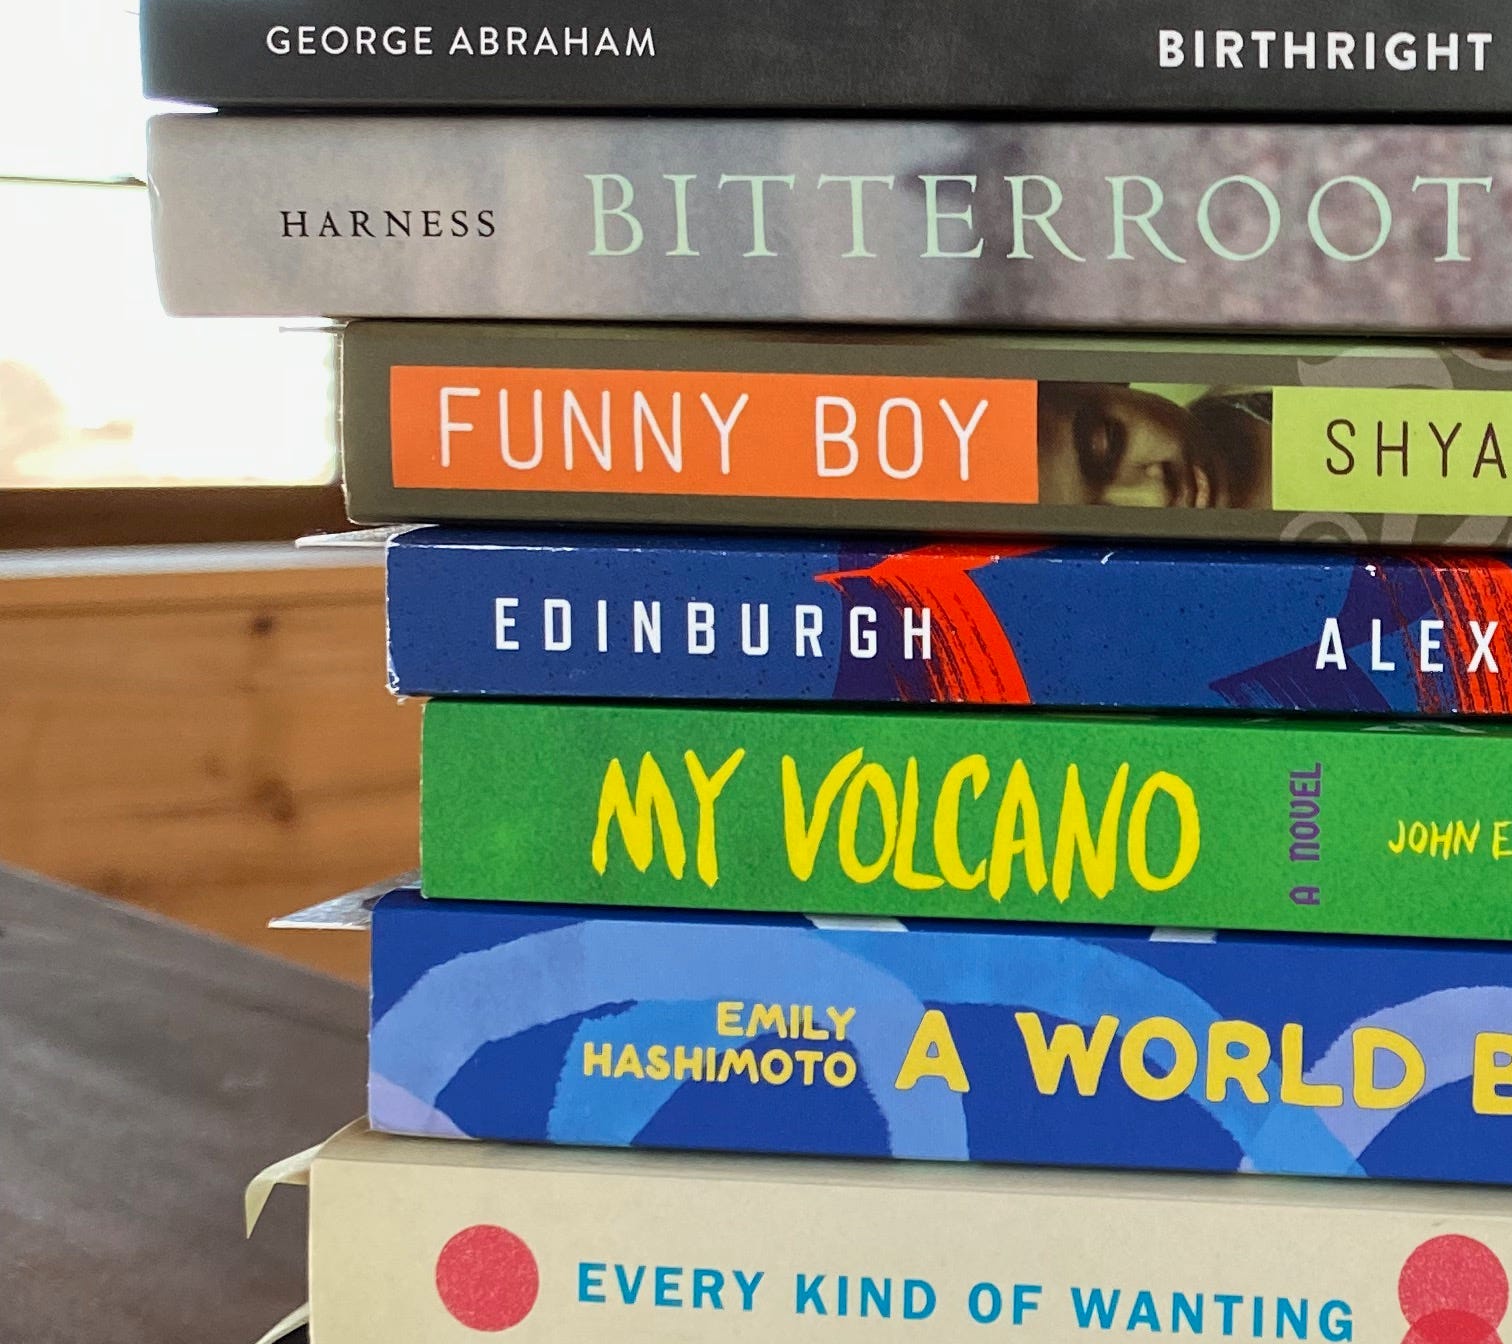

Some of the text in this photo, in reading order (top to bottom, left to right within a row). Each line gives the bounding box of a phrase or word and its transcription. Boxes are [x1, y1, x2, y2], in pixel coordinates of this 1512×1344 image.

[266, 25, 655, 58] GEORGE ABRAHAM
[1159, 29, 1492, 73] BIRTHRIGHT
[280, 209, 497, 239] HARNESS
[586, 173, 1493, 264] BITTERROOT
[438, 386, 989, 482] FUNNY BOY
[495, 597, 933, 661] EDINBURGH
[592, 746, 1201, 903] MY VOLCANO
[1388, 818, 1481, 859] JOHN
[1289, 886, 1321, 905] A
[716, 1001, 856, 1042] EMILY
[582, 1042, 858, 1088] HASHIMOTO
[895, 1009, 971, 1094] A
[1016, 1011, 1427, 1112] WORLD
[578, 1261, 1355, 1344] EVERY KIND OF WANTING
